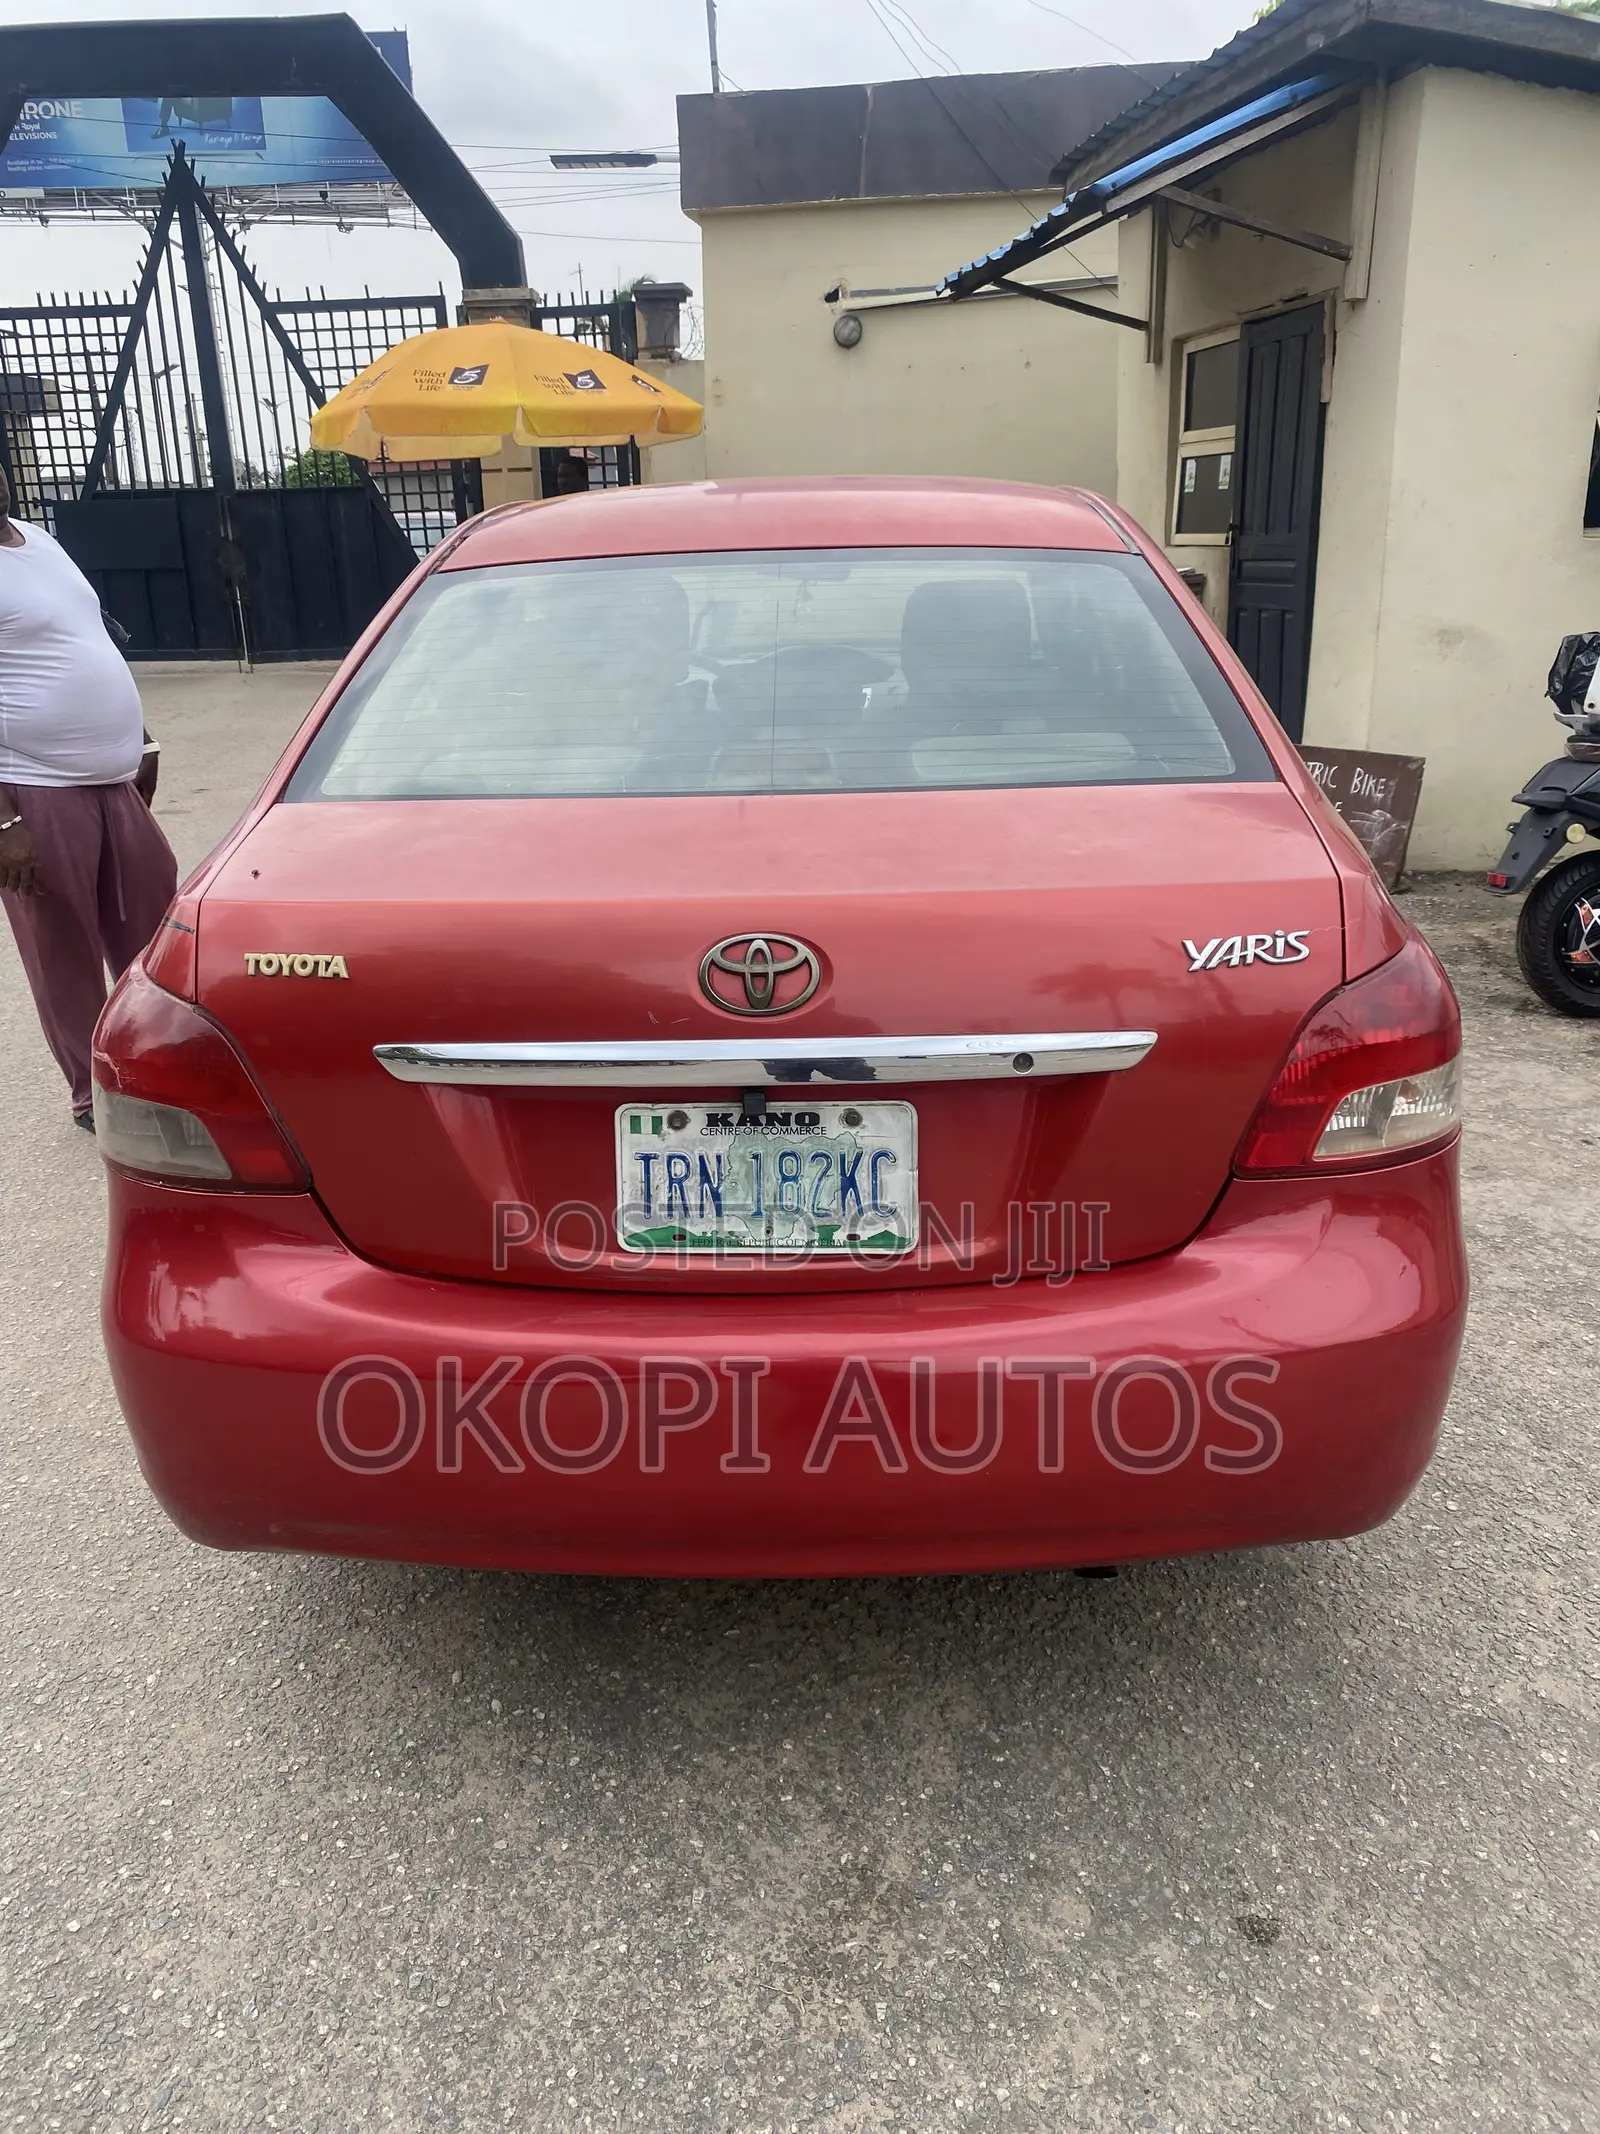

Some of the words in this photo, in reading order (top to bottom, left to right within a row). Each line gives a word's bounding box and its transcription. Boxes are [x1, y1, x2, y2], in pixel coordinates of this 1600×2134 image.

[20, 101, 83, 120] RONE
[9, 131, 58, 141] ELEVISIONS
[412, 369, 447, 378] Filled
[414, 377, 443, 385] with
[418, 383, 441, 392] Life
[1306, 761, 1339, 789] TRIC
[1350, 767, 1387, 797] BIKE
[243, 952, 350, 979] TOYOTA
[705, 1111, 822, 1128] KANO
[699, 1126, 741, 1137] CENTRE
[742, 1126, 759, 1137] OF
[760, 1126, 828, 1137] COMMERCE
[633, 1151, 724, 1220] TRN
